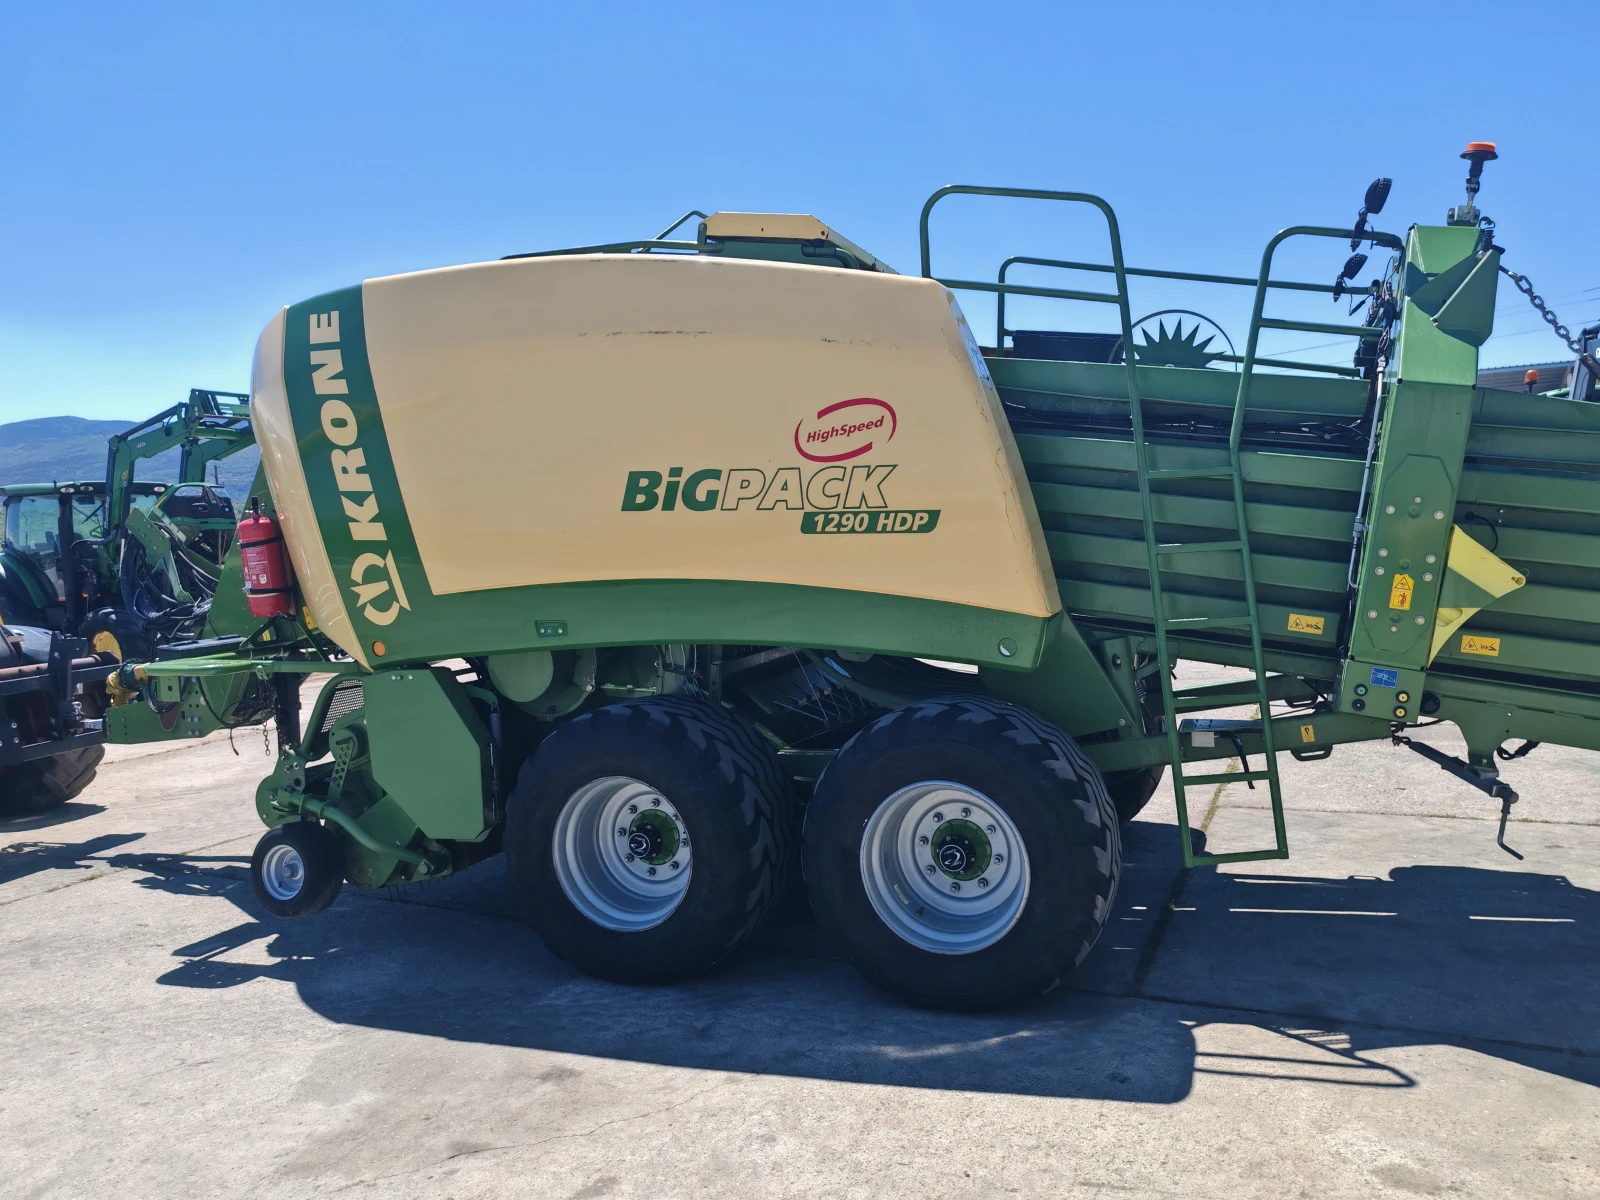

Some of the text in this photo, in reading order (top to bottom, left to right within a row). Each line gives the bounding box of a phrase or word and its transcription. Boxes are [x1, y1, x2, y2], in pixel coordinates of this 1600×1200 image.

[309, 310, 388, 541] KRONE
[806, 415, 885, 444] HighSpeed
[813, 512, 930, 533] 1290 HDP
